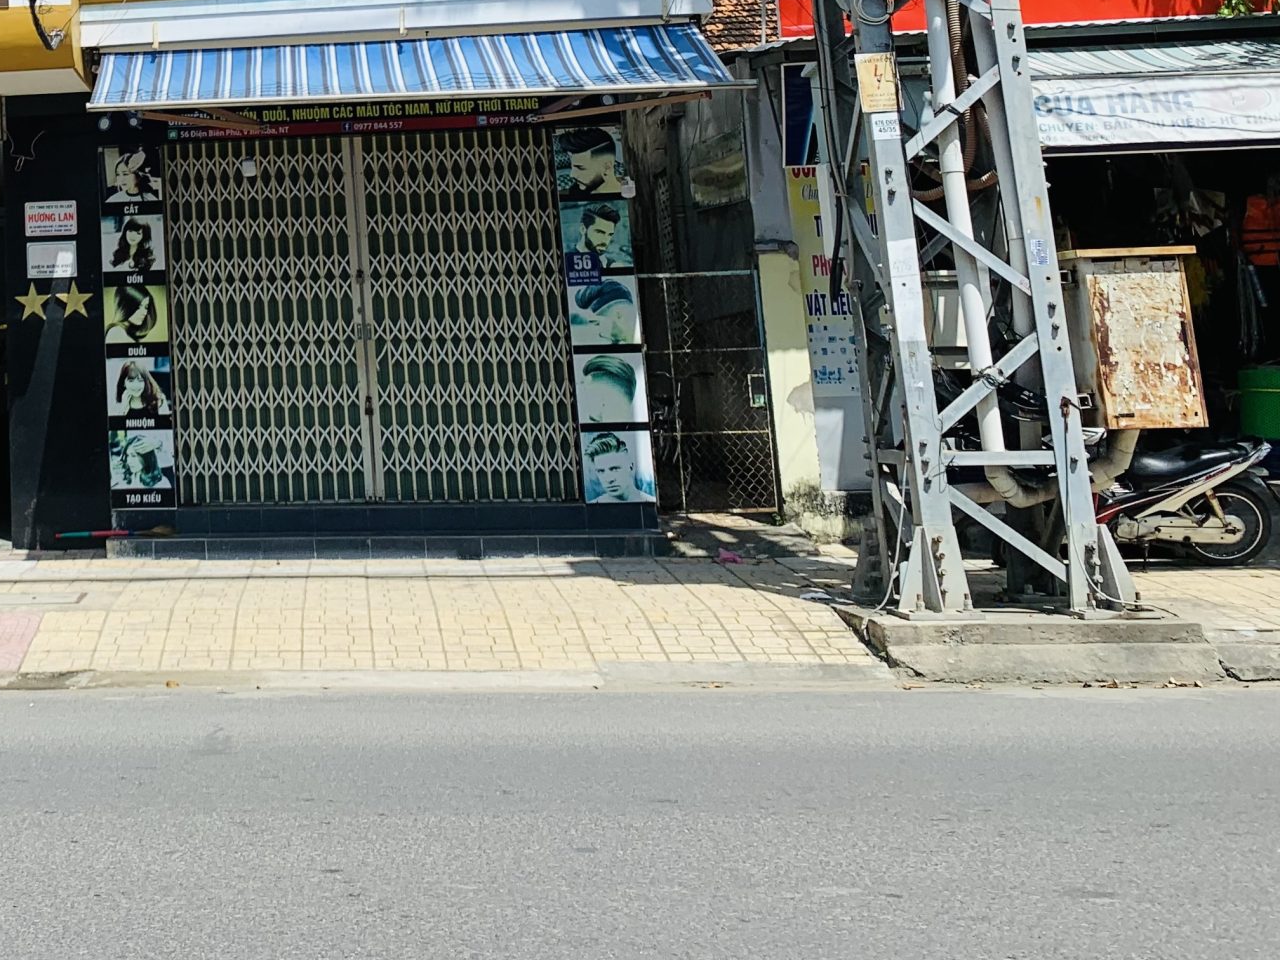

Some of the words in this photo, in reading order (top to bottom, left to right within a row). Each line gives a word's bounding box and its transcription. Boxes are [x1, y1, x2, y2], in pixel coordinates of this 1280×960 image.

[333, 104, 353, 118] CÁC
[383, 102, 402, 116] TÓC
[405, 102, 433, 116] NAM,
[454, 100, 475, 115] HỢP
[504, 97, 539, 111] TRANG
[389, 121, 403, 129] 557
[180, 130, 189, 138] 56
[279, 126, 289, 134] NT
[59, 212, 74, 222] LAN
[573, 255, 591, 270] 56
[126, 418, 155, 428] NHUỘM
[126, 493, 141, 504] TẠO
